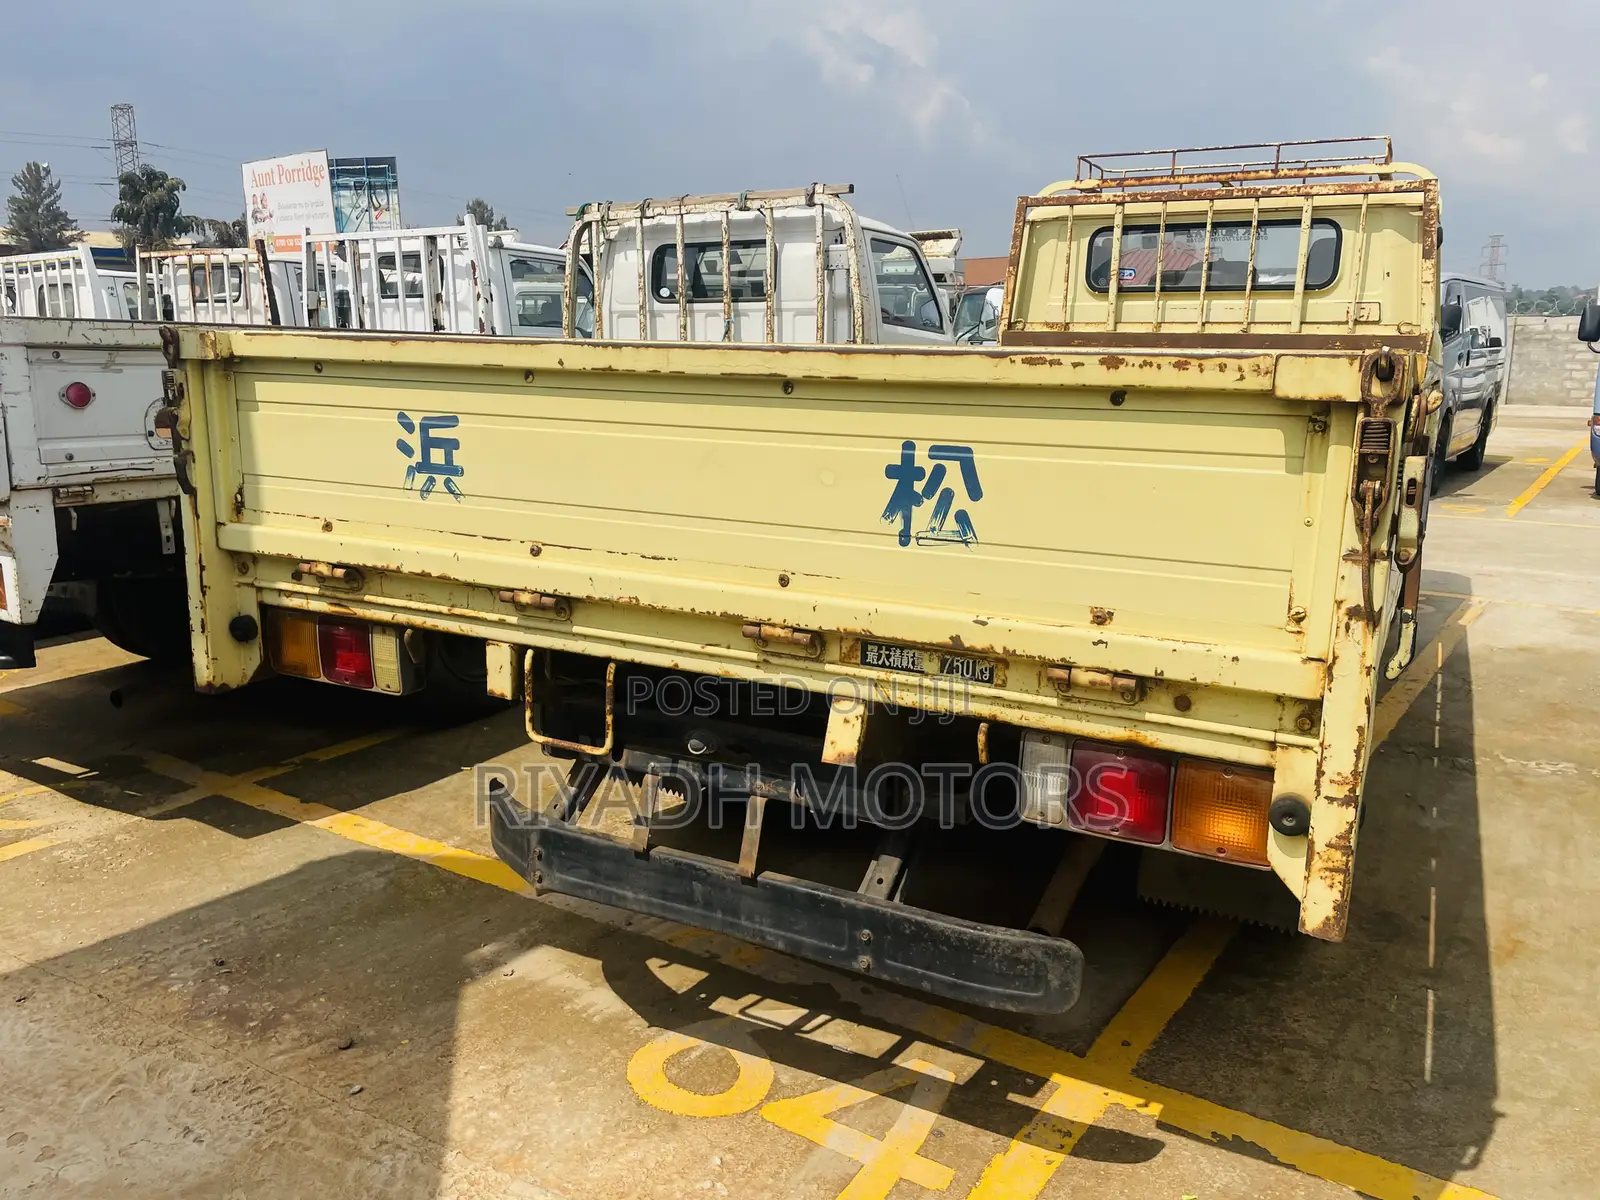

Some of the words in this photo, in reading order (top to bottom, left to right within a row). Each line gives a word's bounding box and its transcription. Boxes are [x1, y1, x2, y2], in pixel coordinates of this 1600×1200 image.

[251, 167, 275, 188] Aunt
[277, 159, 325, 188] Porridge
[396, 411, 465, 503] 浜
[880, 440, 984, 548] 松
